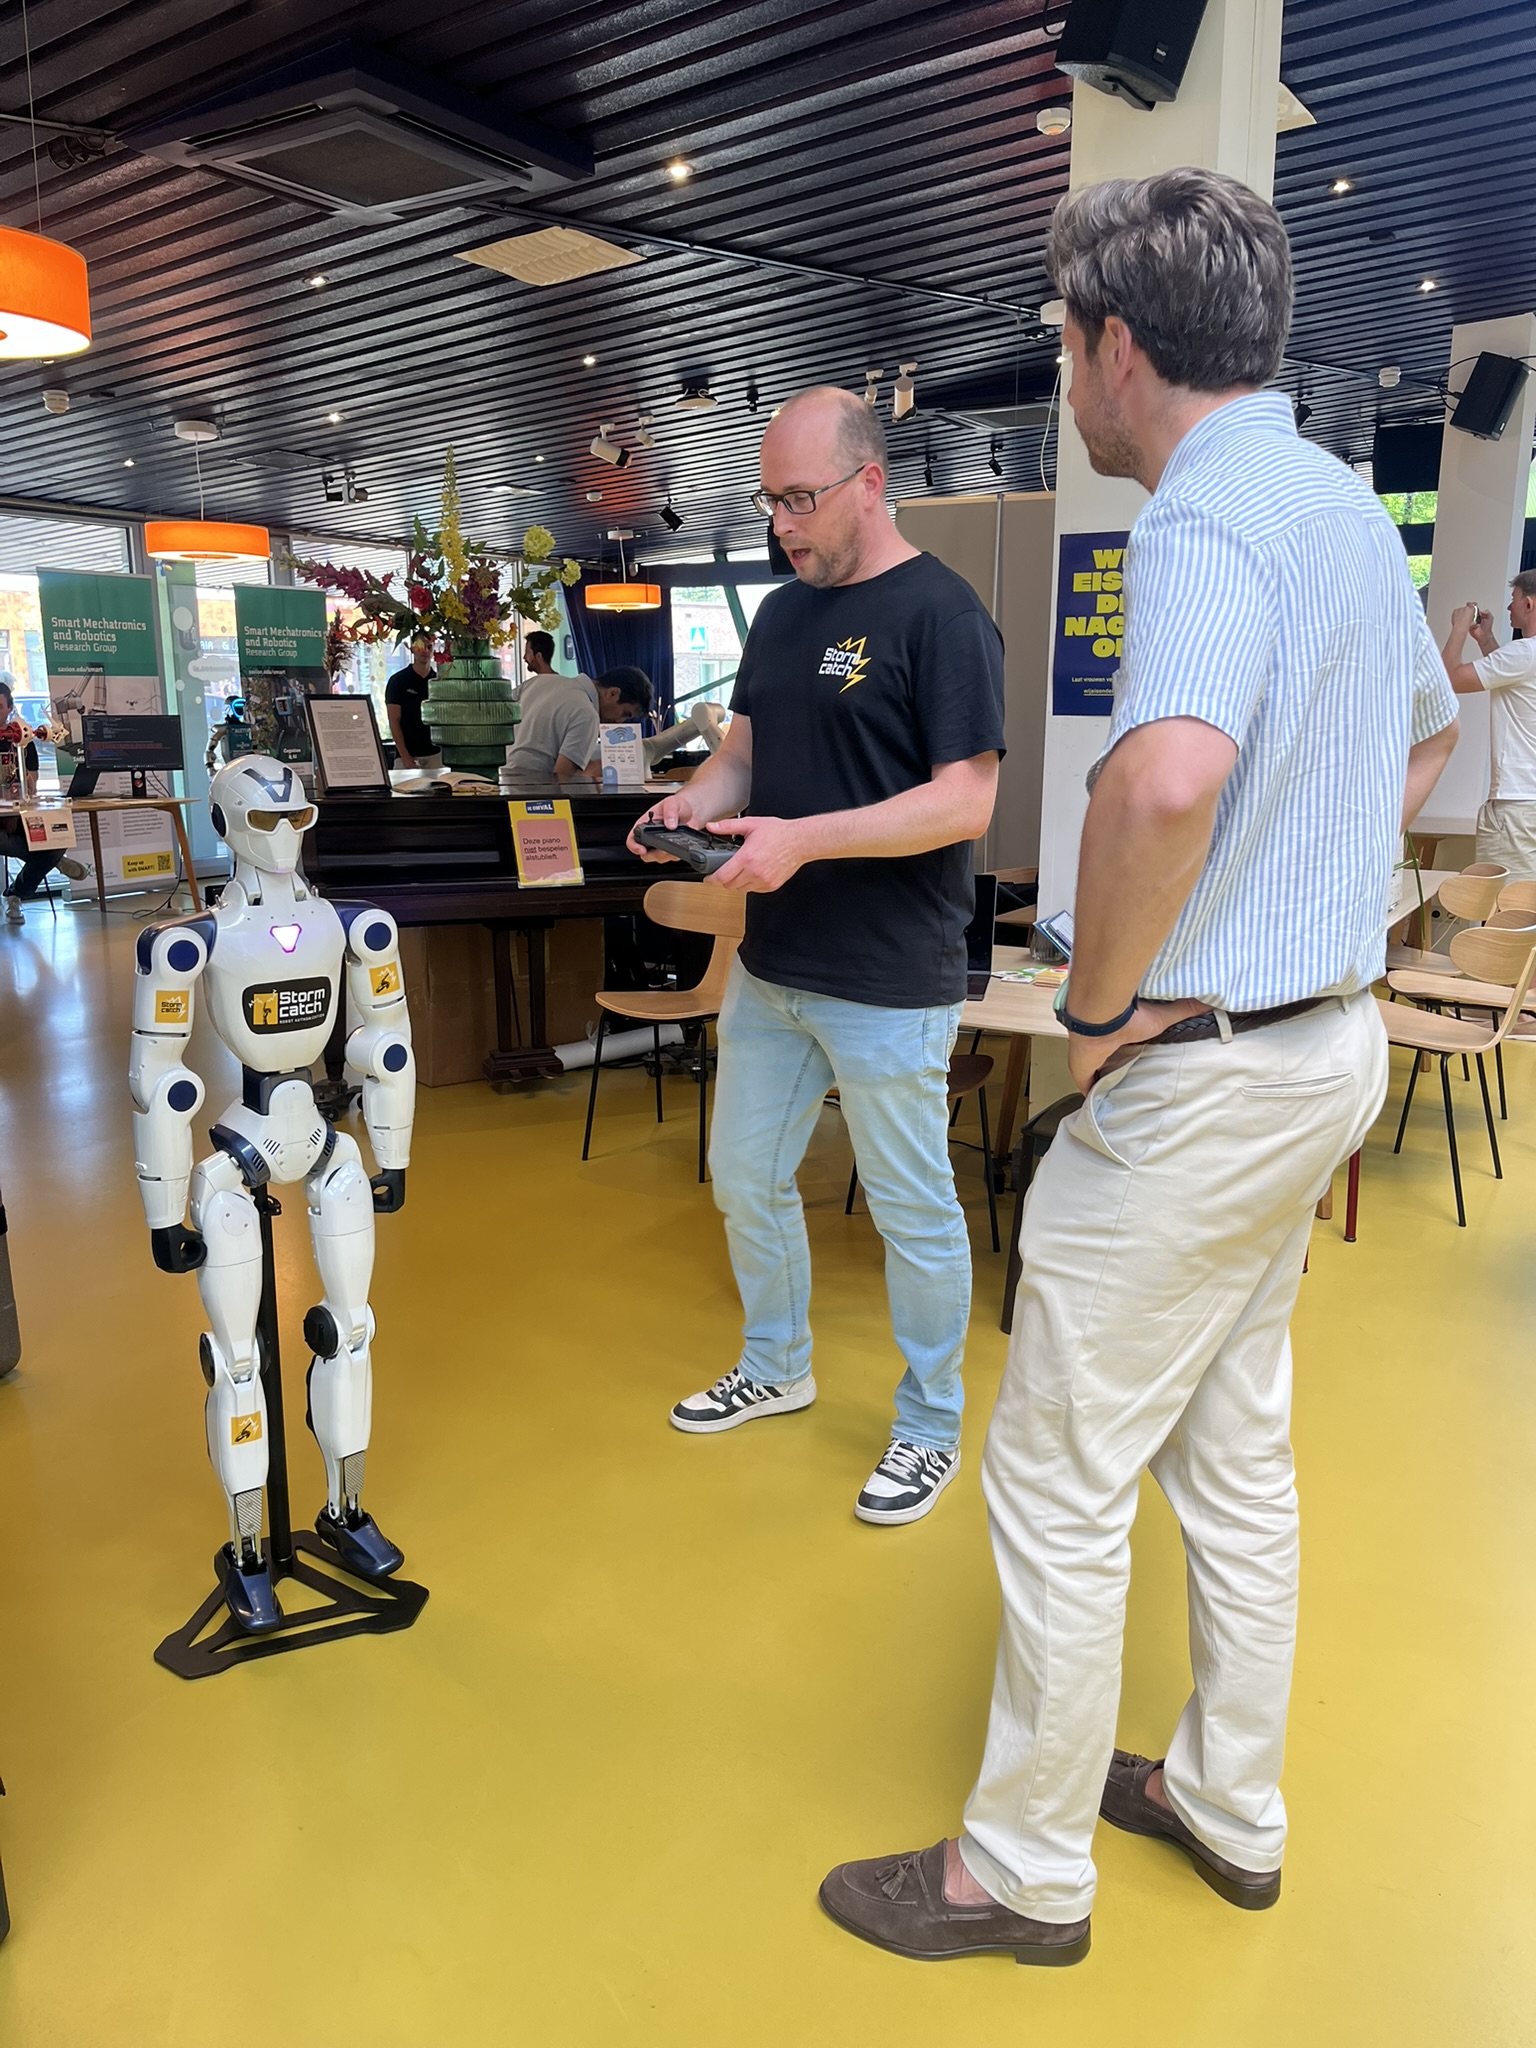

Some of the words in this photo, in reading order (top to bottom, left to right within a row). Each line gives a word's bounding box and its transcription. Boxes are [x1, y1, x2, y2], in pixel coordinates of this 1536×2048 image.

[1073, 571, 1123, 592] EIS
[51, 617, 81, 628] Smart
[83, 617, 147, 631] Mechatronics
[1064, 616, 1125, 637] NAC
[53, 629, 72, 641] and
[74, 630, 117, 642] Robotics
[244, 626, 268, 636] Smart
[270, 627, 322, 638] Mechatronics
[53, 642, 91, 652] Research
[93, 643, 118, 654] Group
[245, 637, 261, 647] and
[263, 638, 297, 648] Robotics
[246, 648, 276, 657] Research
[277, 649, 298, 658] Group
[823, 647, 861, 665] Storm
[818, 662, 853, 677] catch
[542, 837, 561, 845] piano
[538, 845, 569, 853] bespelen
[280, 988, 325, 1006] Storm
[279, 1000, 322, 1018] catch
